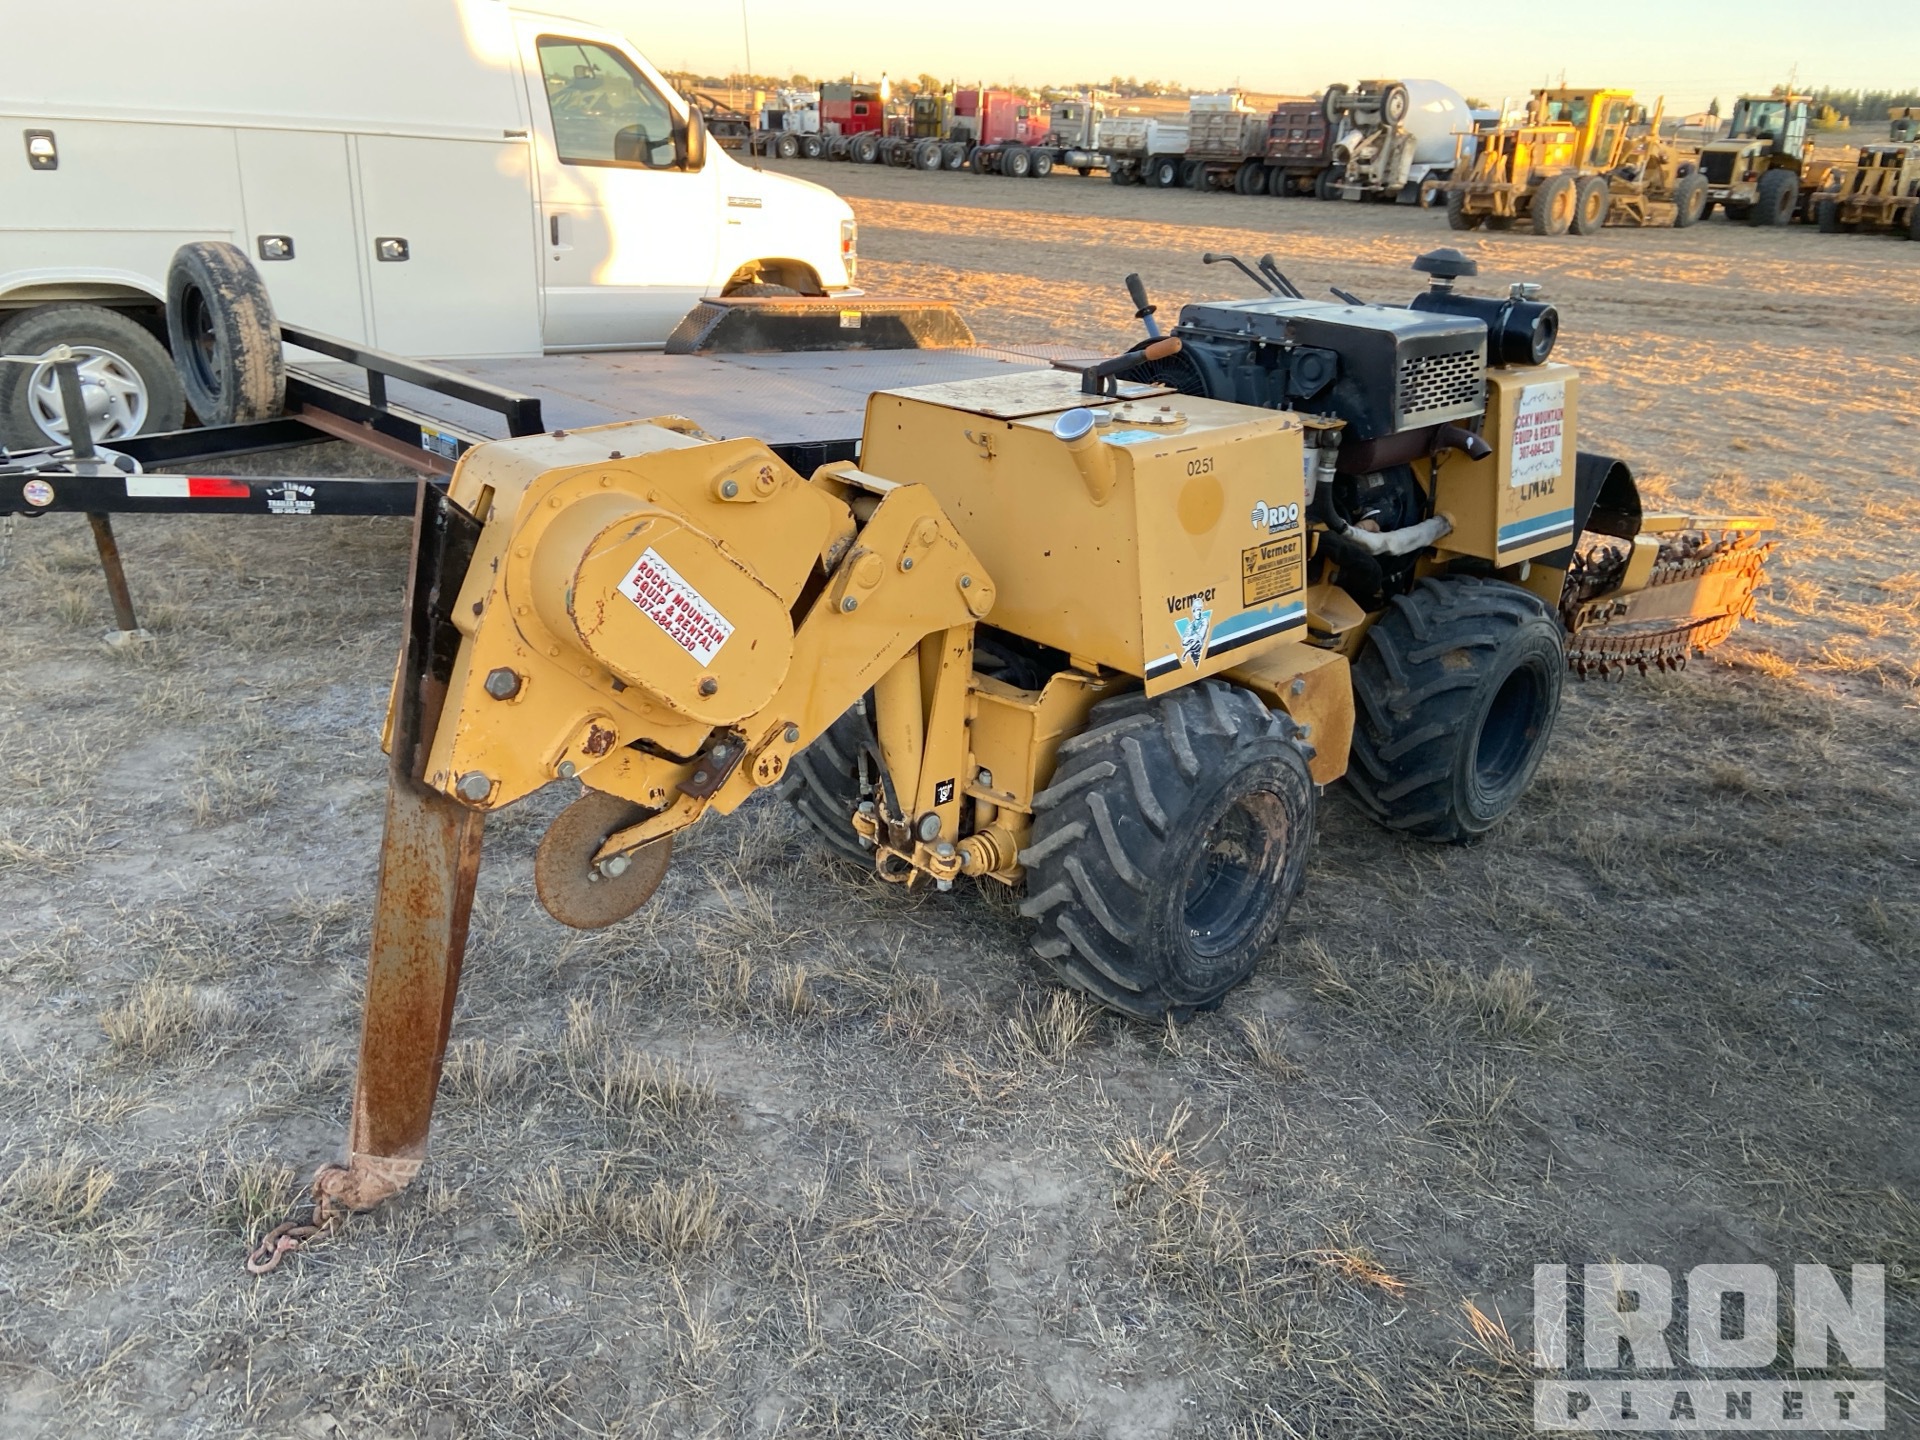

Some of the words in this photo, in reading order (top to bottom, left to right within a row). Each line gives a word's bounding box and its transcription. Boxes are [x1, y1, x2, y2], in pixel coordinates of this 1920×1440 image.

[1534, 408, 1564, 425] MOUNTAIN
[1514, 429, 1532, 445] EQUIP
[1540, 424, 1561, 440] RENTAL
[1187, 457, 1214, 476] 0251
[1269, 502, 1299, 527] RDO
[1260, 542, 1296, 560] Vermeer
[632, 574, 666, 606] EQUIP
[665, 605, 675, 617] &
[675, 613, 712, 652] RENTAL
[638, 561, 674, 597] ROCKY
[672, 593, 725, 645] MOUNTAIN
[1167, 588, 1216, 614] Vermeer
[632, 593, 697, 652] 307-684-2130
